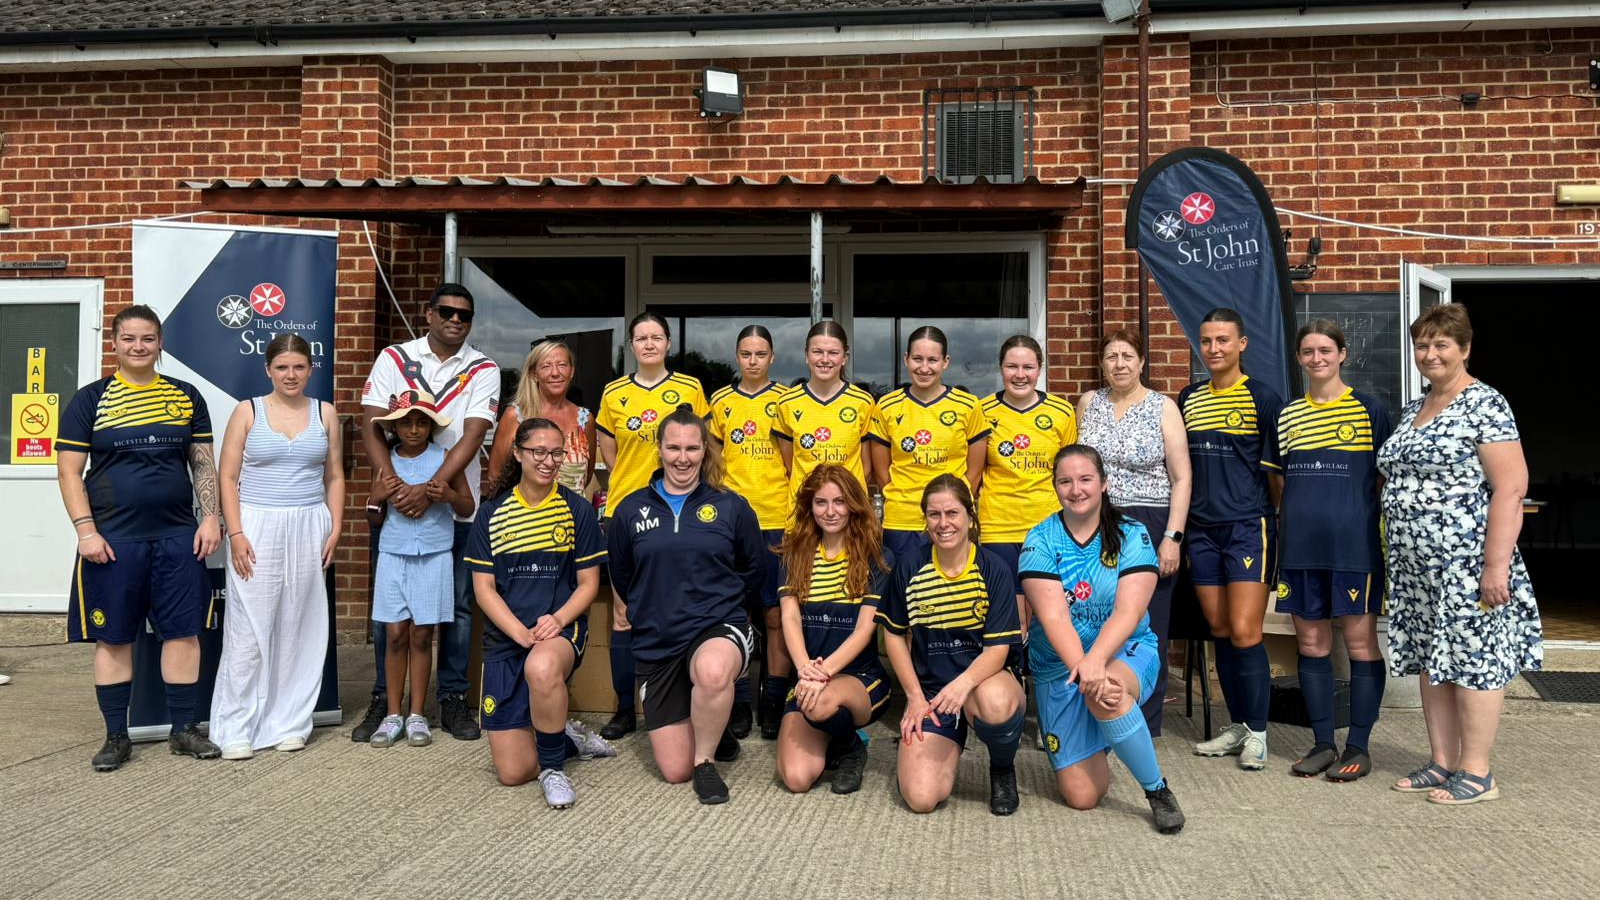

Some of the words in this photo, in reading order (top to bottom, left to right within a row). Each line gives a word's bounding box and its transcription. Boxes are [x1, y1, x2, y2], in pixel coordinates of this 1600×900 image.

[1190, 228, 1205, 238] The
[1207, 222, 1238, 235] Orders
[1239, 217, 1250, 230] of
[1579, 223, 1600, 235] 19
[1178, 241, 1202, 265] St
[1204, 234, 1259, 268] John
[1213, 261, 1235, 271] Care
[1237, 258, 1259, 269] Trust
[255, 318, 272, 329] The
[273, 319, 306, 330] Orders
[307, 320, 318, 330] of
[240, 330, 265, 355] St
[113, 438, 148, 447] BICESTER
[638, 430, 650, 442] St
[750, 442, 775, 458] John
[811, 449, 823, 461] St
[823, 448, 848, 464] John
[912, 452, 922, 464] St
[925, 451, 949, 467] John
[1009, 456, 1021, 469] St
[1022, 455, 1049, 473] John
[635, 517, 660, 533] NM
